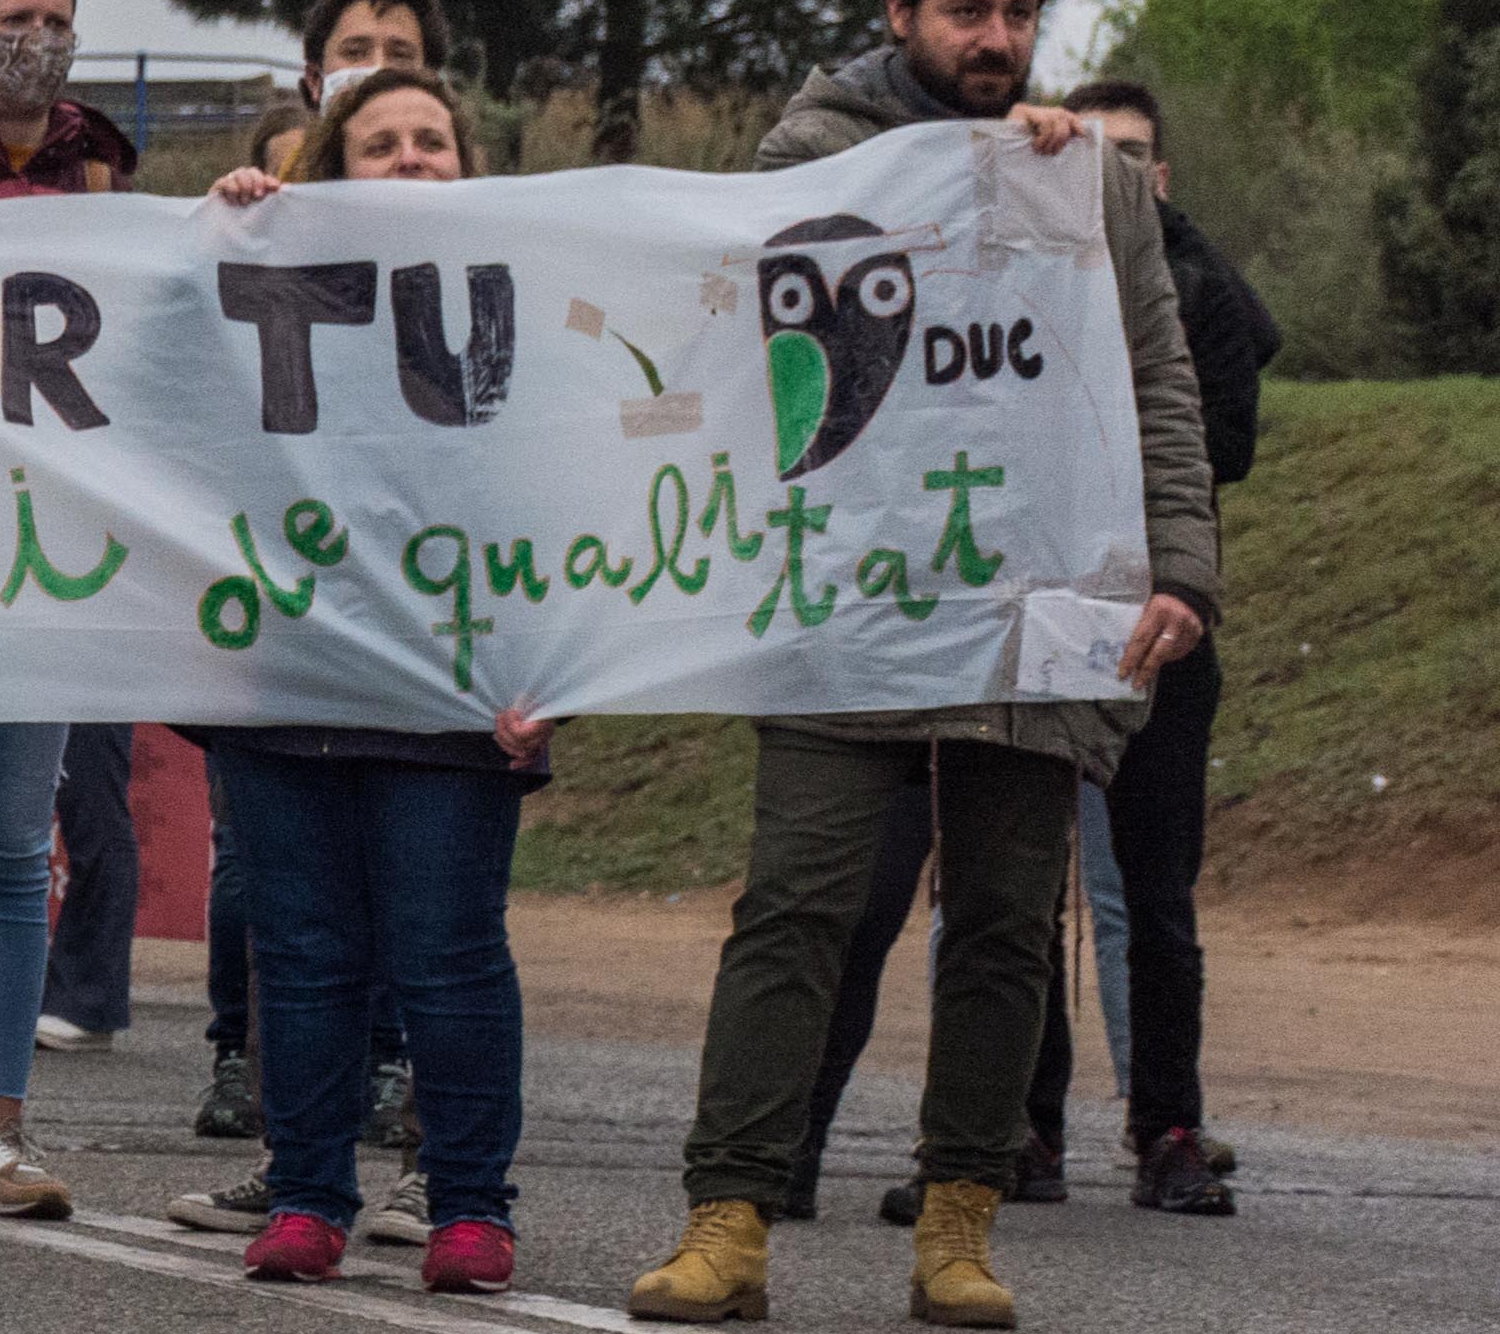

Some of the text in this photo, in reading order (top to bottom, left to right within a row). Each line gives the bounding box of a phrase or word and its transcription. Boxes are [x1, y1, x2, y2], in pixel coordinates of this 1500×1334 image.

[216, 260, 516, 435] TU
[924, 317, 1045, 385] DUC
[196, 497, 351, 651] de
[400, 450, 1006, 694] qualitat
